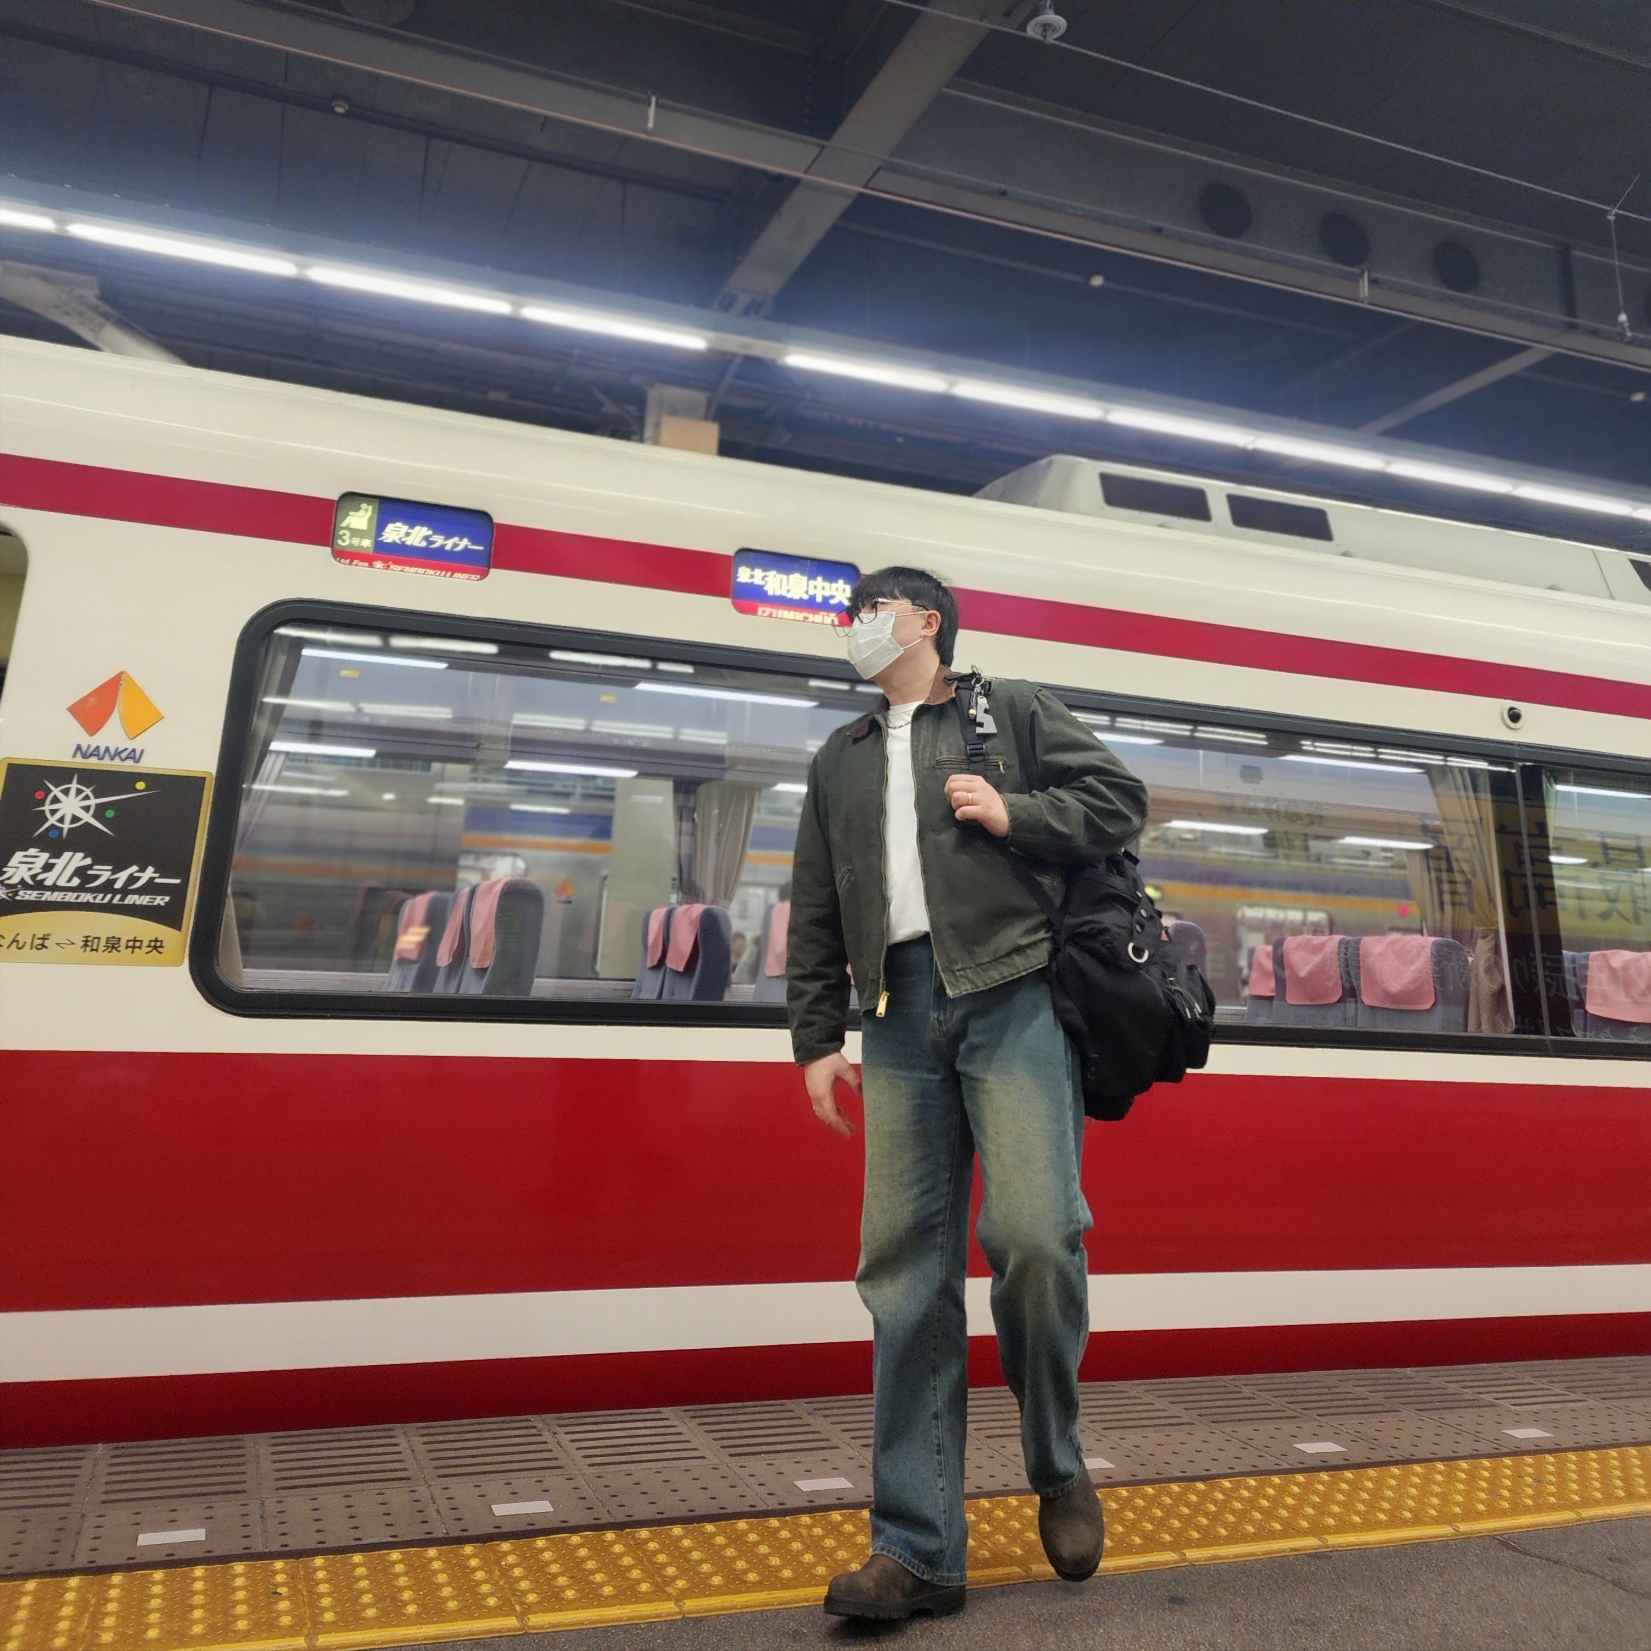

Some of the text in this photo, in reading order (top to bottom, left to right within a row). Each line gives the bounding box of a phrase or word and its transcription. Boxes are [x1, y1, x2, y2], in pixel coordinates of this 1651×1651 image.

[377, 522, 485, 551] 泉北ライナー
[72, 744, 144, 763] NANKAI
[0, 848, 182, 889] 泉北ライナー
[15, 890, 170, 906] SEMBOKU LINER
[80, 935, 165, 955] 和泉中央
